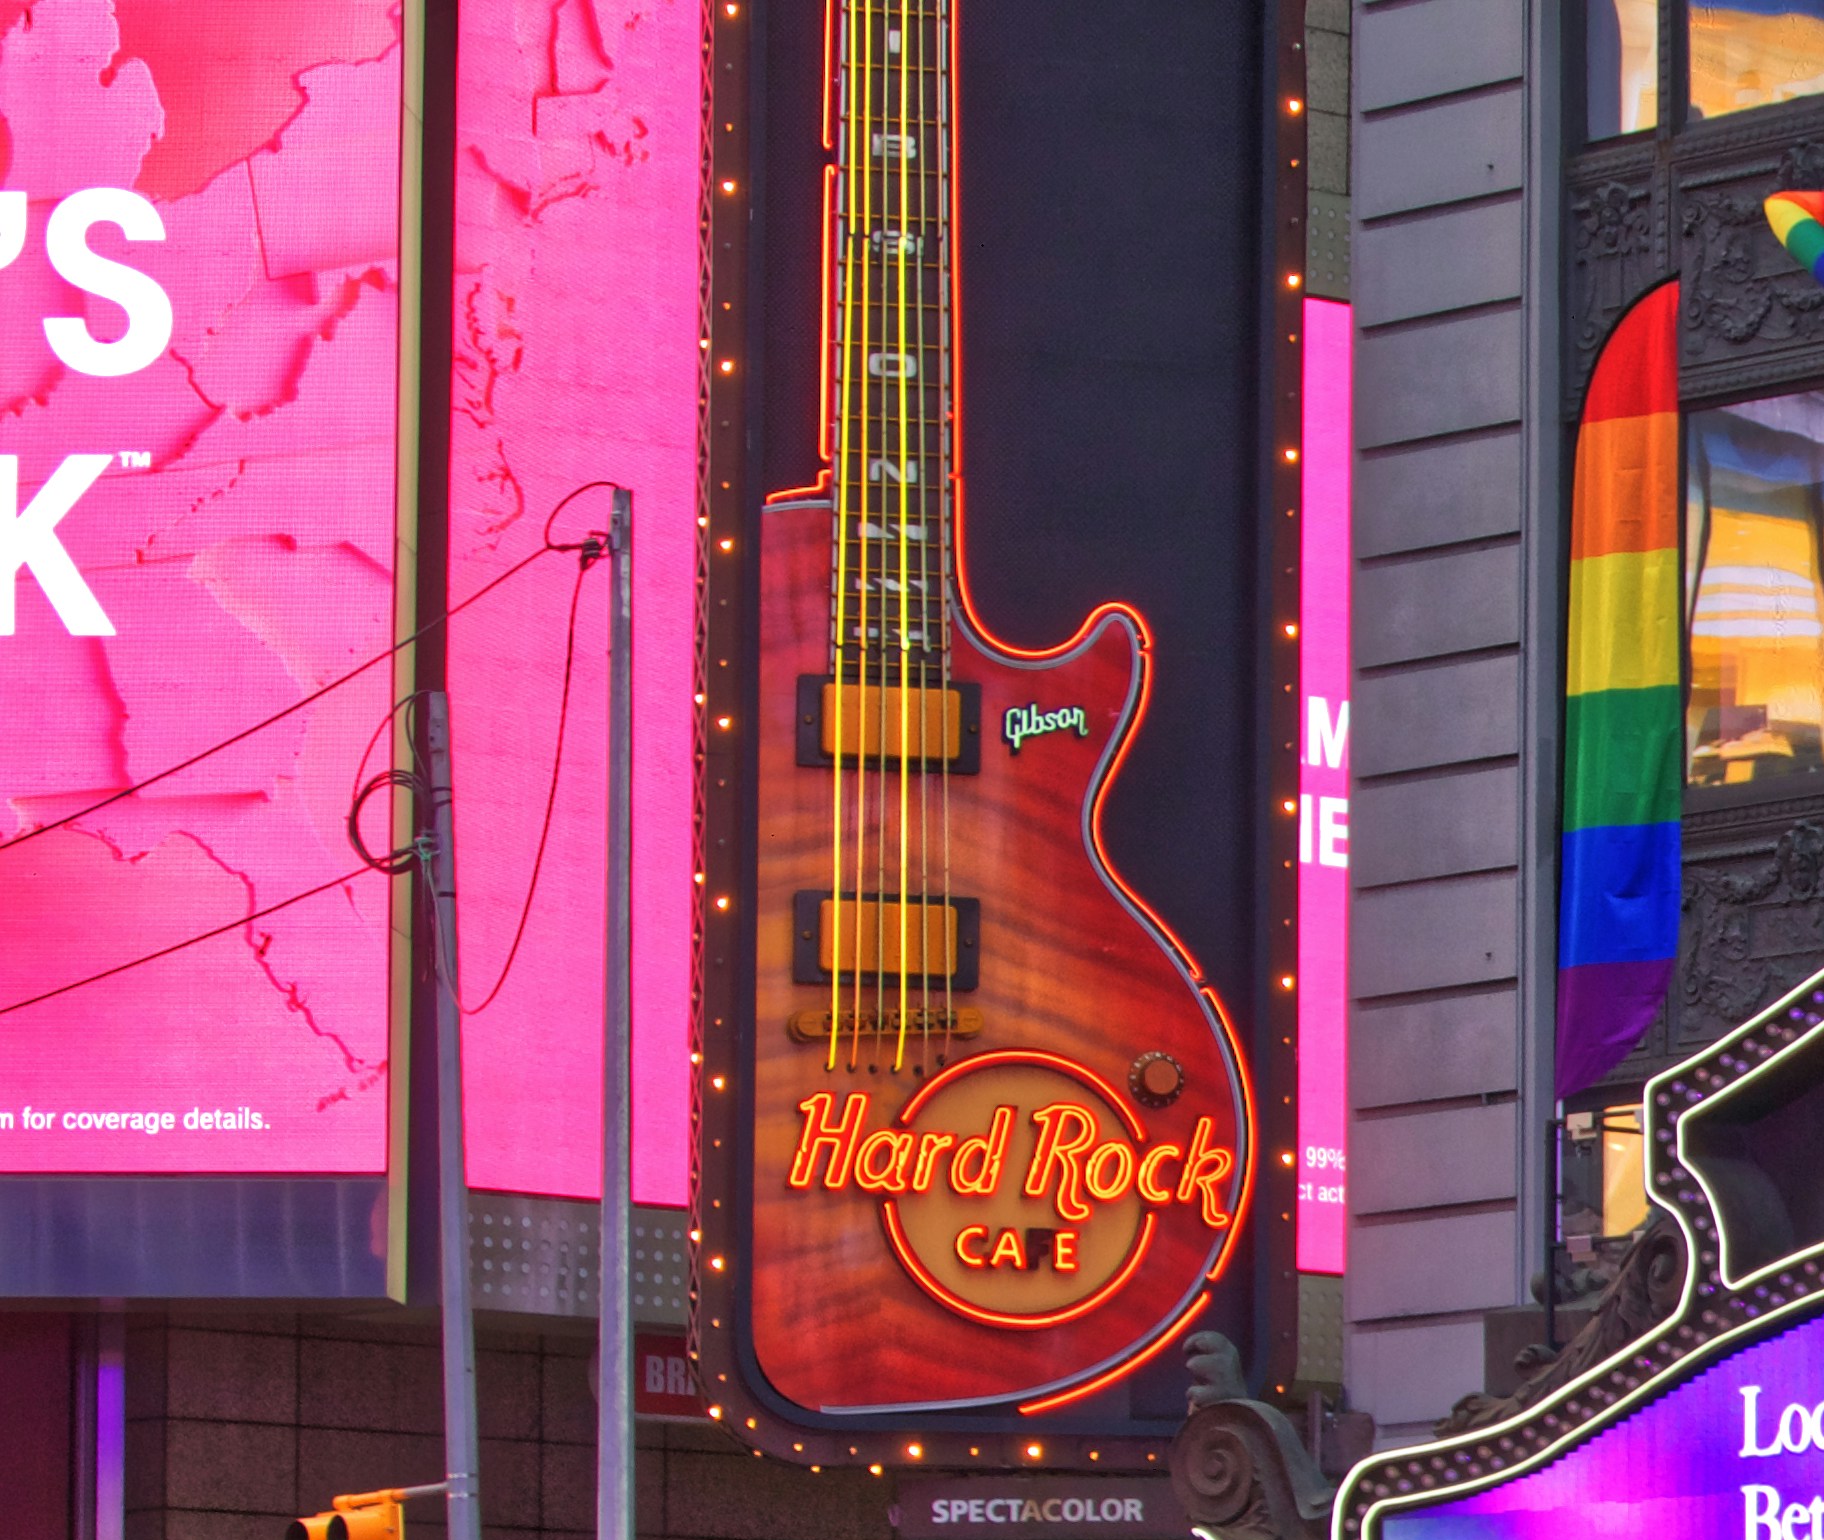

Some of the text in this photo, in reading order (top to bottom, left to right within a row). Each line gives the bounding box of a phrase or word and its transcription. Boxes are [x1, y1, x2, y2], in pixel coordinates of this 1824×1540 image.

[1004, 703, 1089, 749] Gibson
[22, 1106, 56, 1130] for
[62, 1111, 176, 1134] coverage
[183, 1107, 271, 1130] details.
[789, 1092, 1234, 1228] Hard Rock
[955, 1224, 1080, 1273] CAFE
[931, 1498, 1144, 1524] SPECTACOLOR
